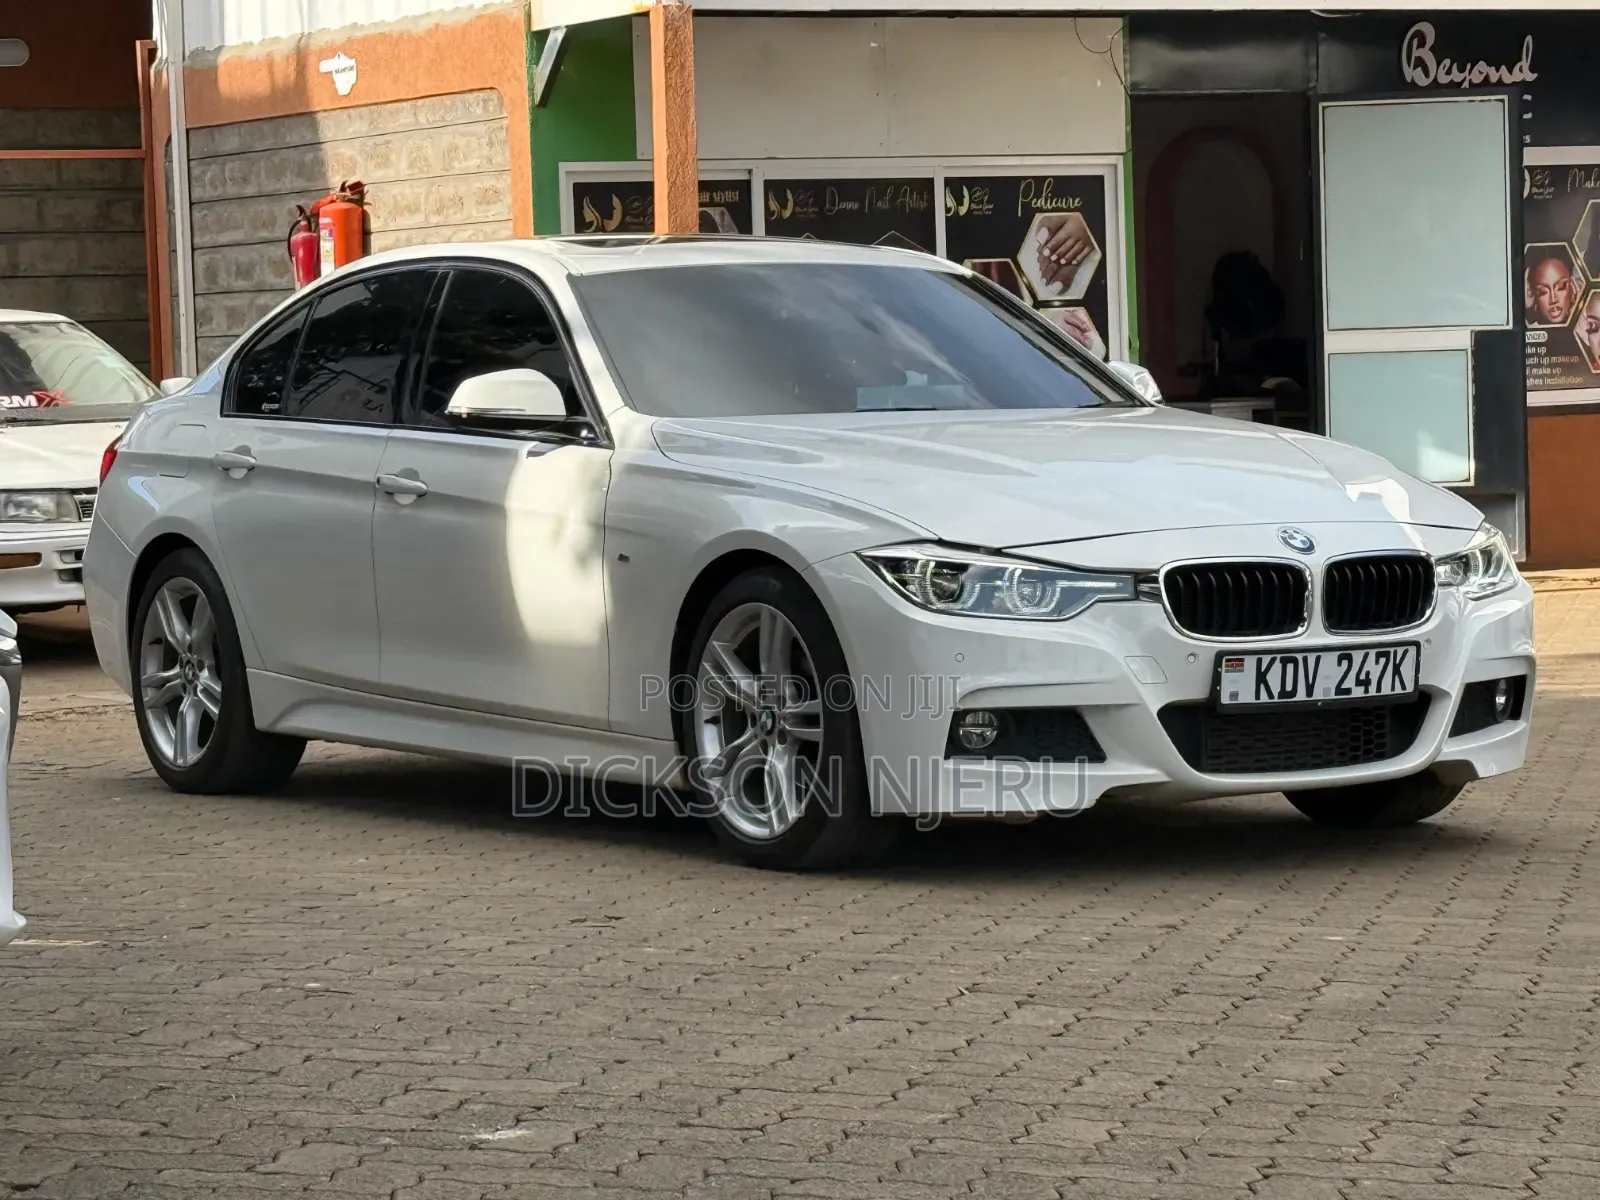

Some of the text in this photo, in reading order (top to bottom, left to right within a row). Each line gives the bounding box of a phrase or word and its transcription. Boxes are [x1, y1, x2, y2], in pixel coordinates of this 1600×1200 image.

[1402, 21, 1538, 88] Beyond
[713, 190, 739, 203] stylist
[865, 185, 893, 213] Nail
[895, 185, 928, 213] Artist
[1018, 178, 1082, 217] Pedicure
[1526, 332, 1546, 340] VICES
[1525, 356, 1539, 365] uch
[1532, 366, 1551, 375] make
[1255, 648, 1409, 700] KDV 247K
